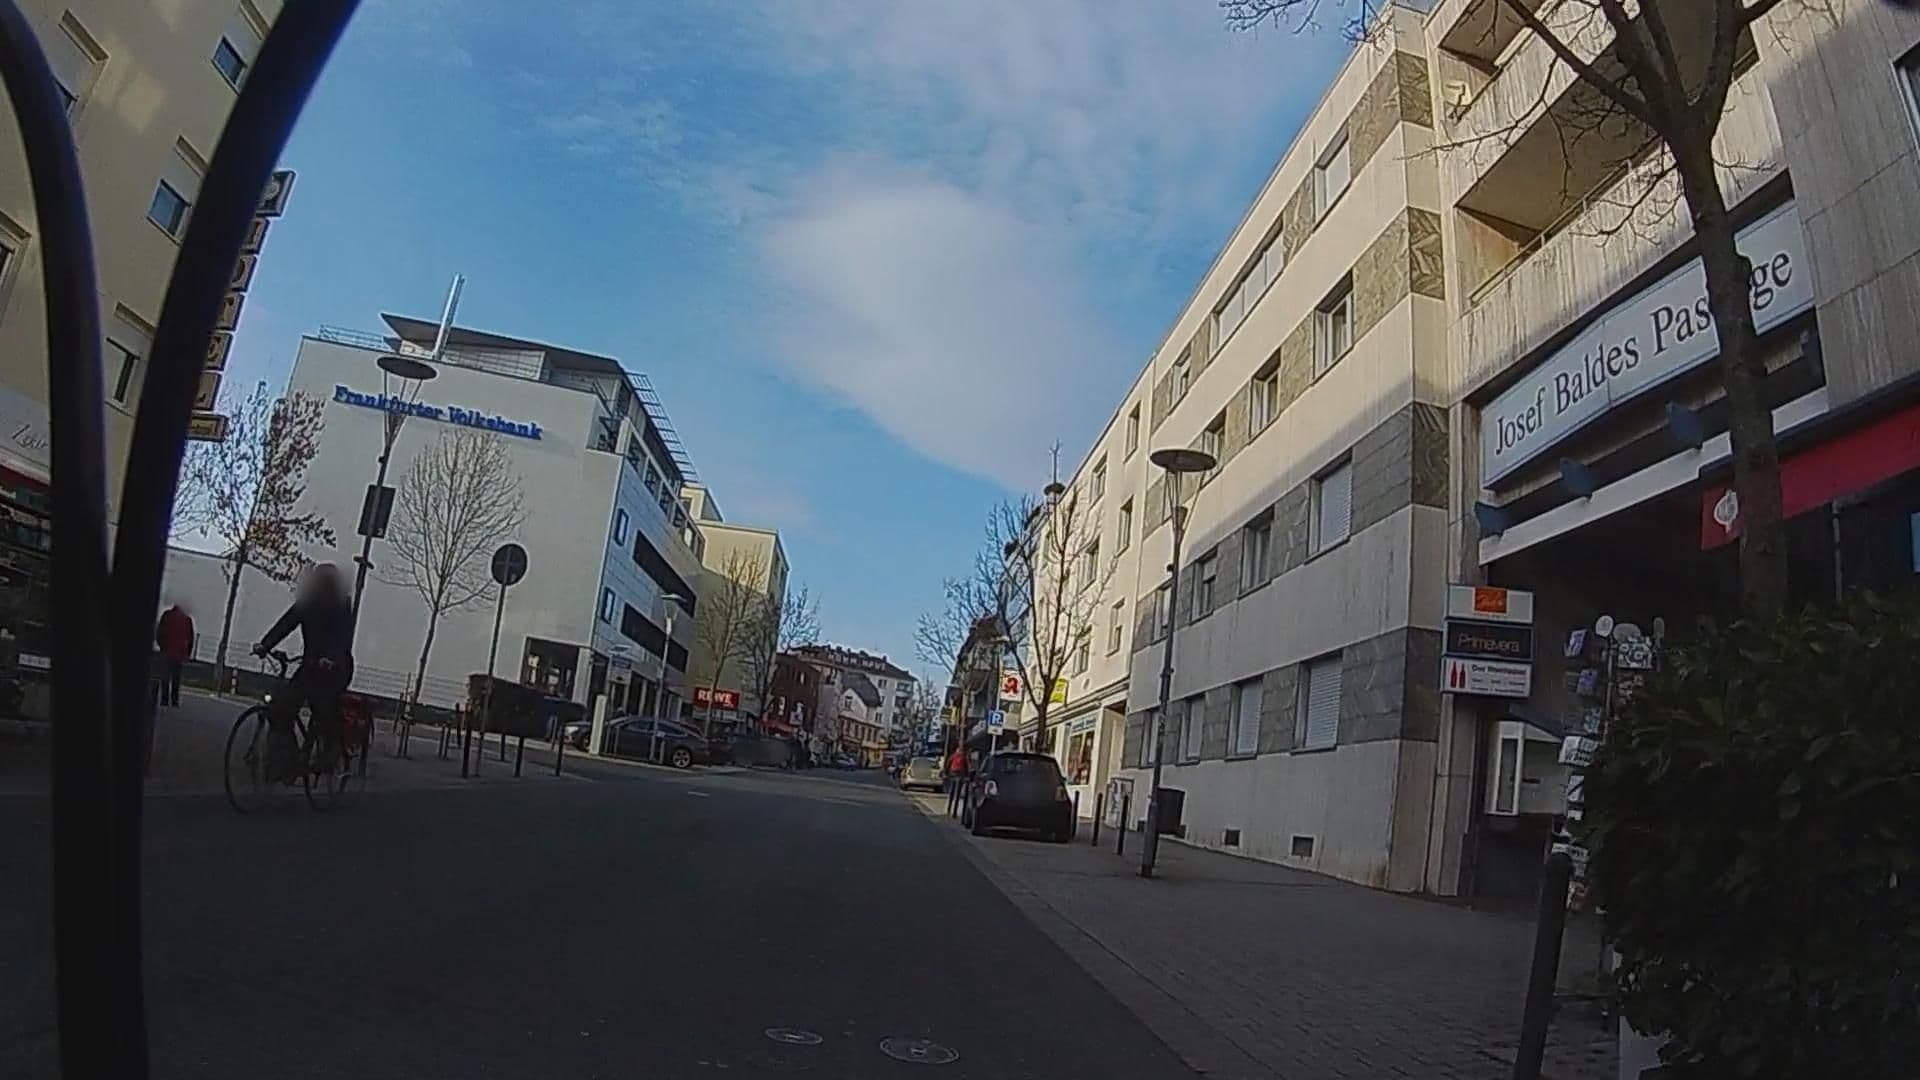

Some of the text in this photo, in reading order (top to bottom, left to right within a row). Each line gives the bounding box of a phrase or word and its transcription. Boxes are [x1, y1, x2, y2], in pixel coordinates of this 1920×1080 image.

[1496, 252, 1793, 455] Josef Baldes Pasge
[333, 386, 543, 439] Frankfurter Volksbank
[1458, 633, 1520, 653] Primavera
